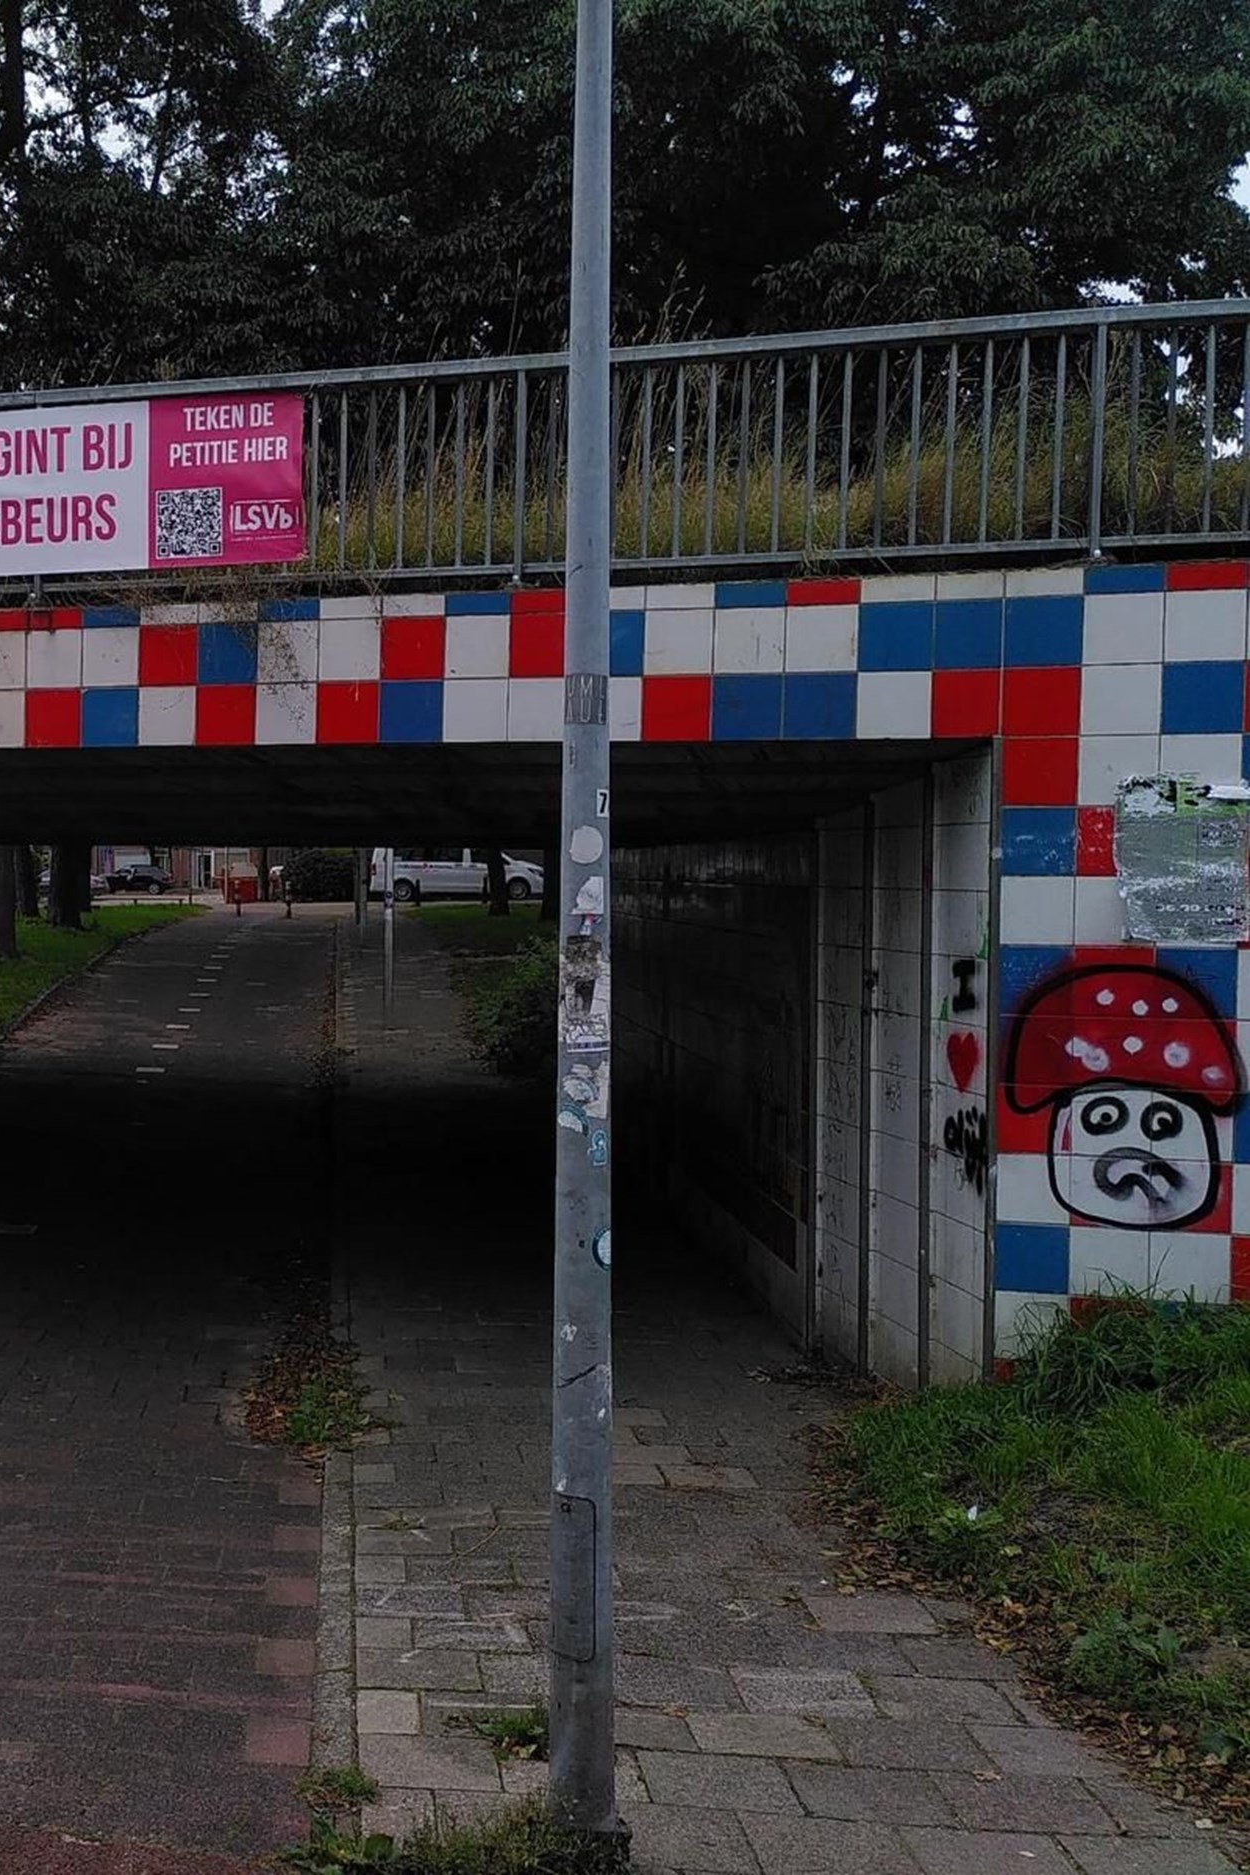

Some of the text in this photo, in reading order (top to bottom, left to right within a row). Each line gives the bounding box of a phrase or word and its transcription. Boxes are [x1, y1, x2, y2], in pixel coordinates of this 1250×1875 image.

[183, 402, 274, 432] TEKEN DE
[83, 423, 132, 471] BIJ
[170, 436, 288, 467] PETITIE HIER
[234, 504, 293, 530] LSVb
[599, 791, 607, 814] 7
